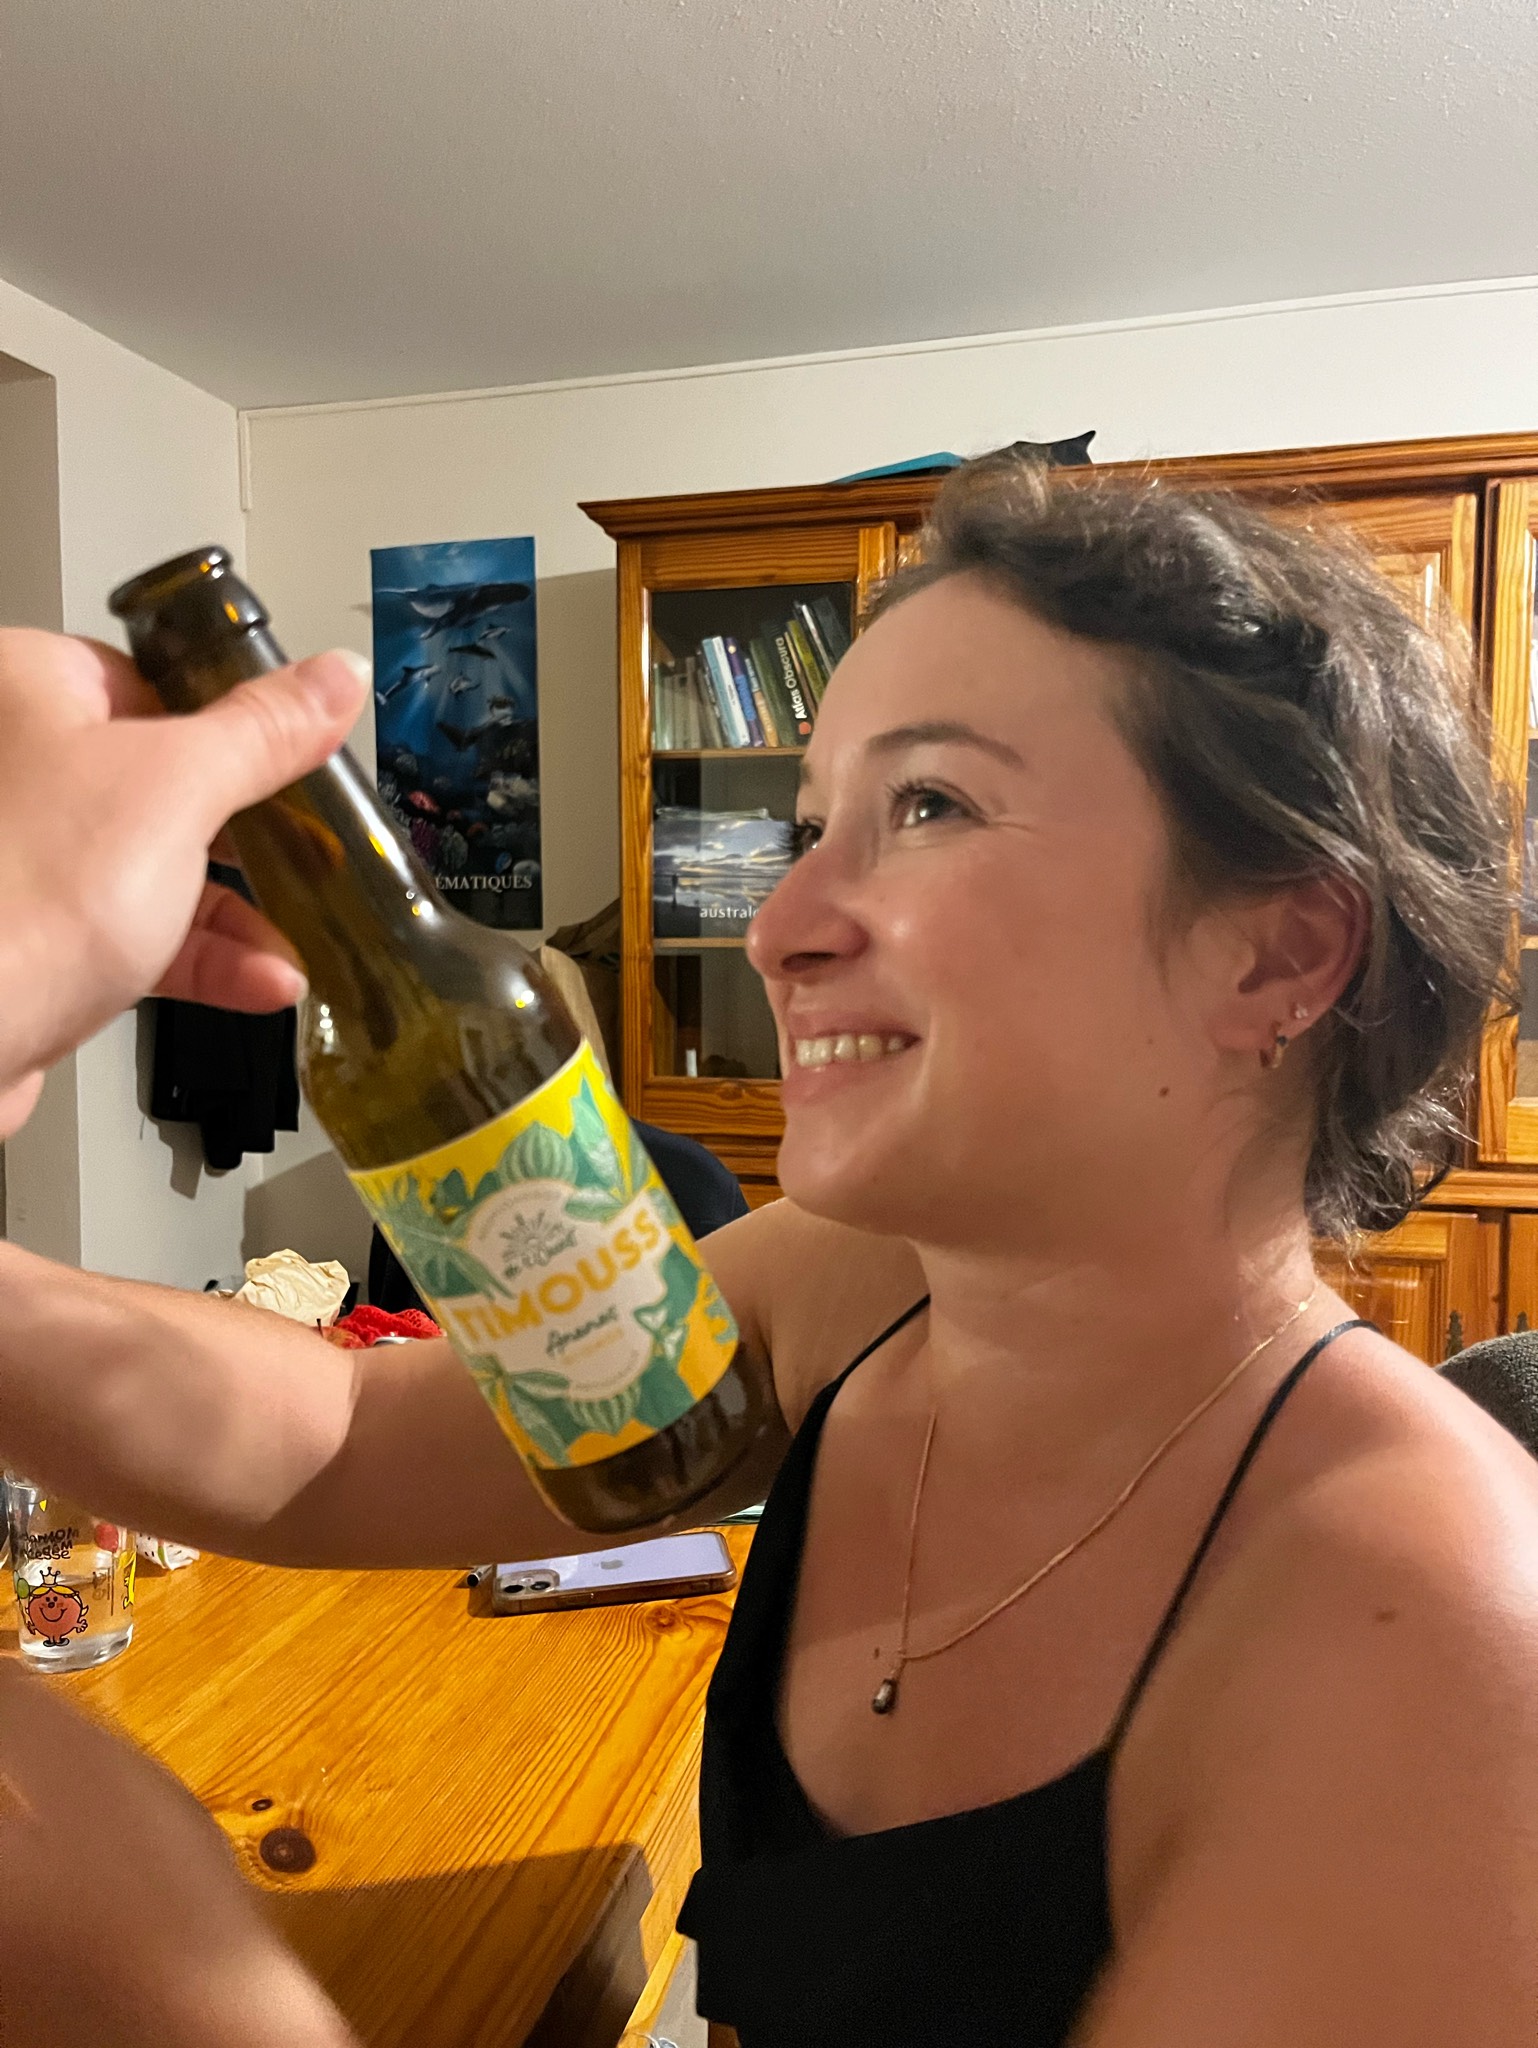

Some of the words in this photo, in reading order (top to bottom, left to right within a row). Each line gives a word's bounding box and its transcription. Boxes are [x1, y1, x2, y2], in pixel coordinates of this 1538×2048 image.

[775, 637, 797, 689] Obscura
[791, 689, 807, 719] Atlas
[435, 873, 533, 893] ÉMATIQUES
